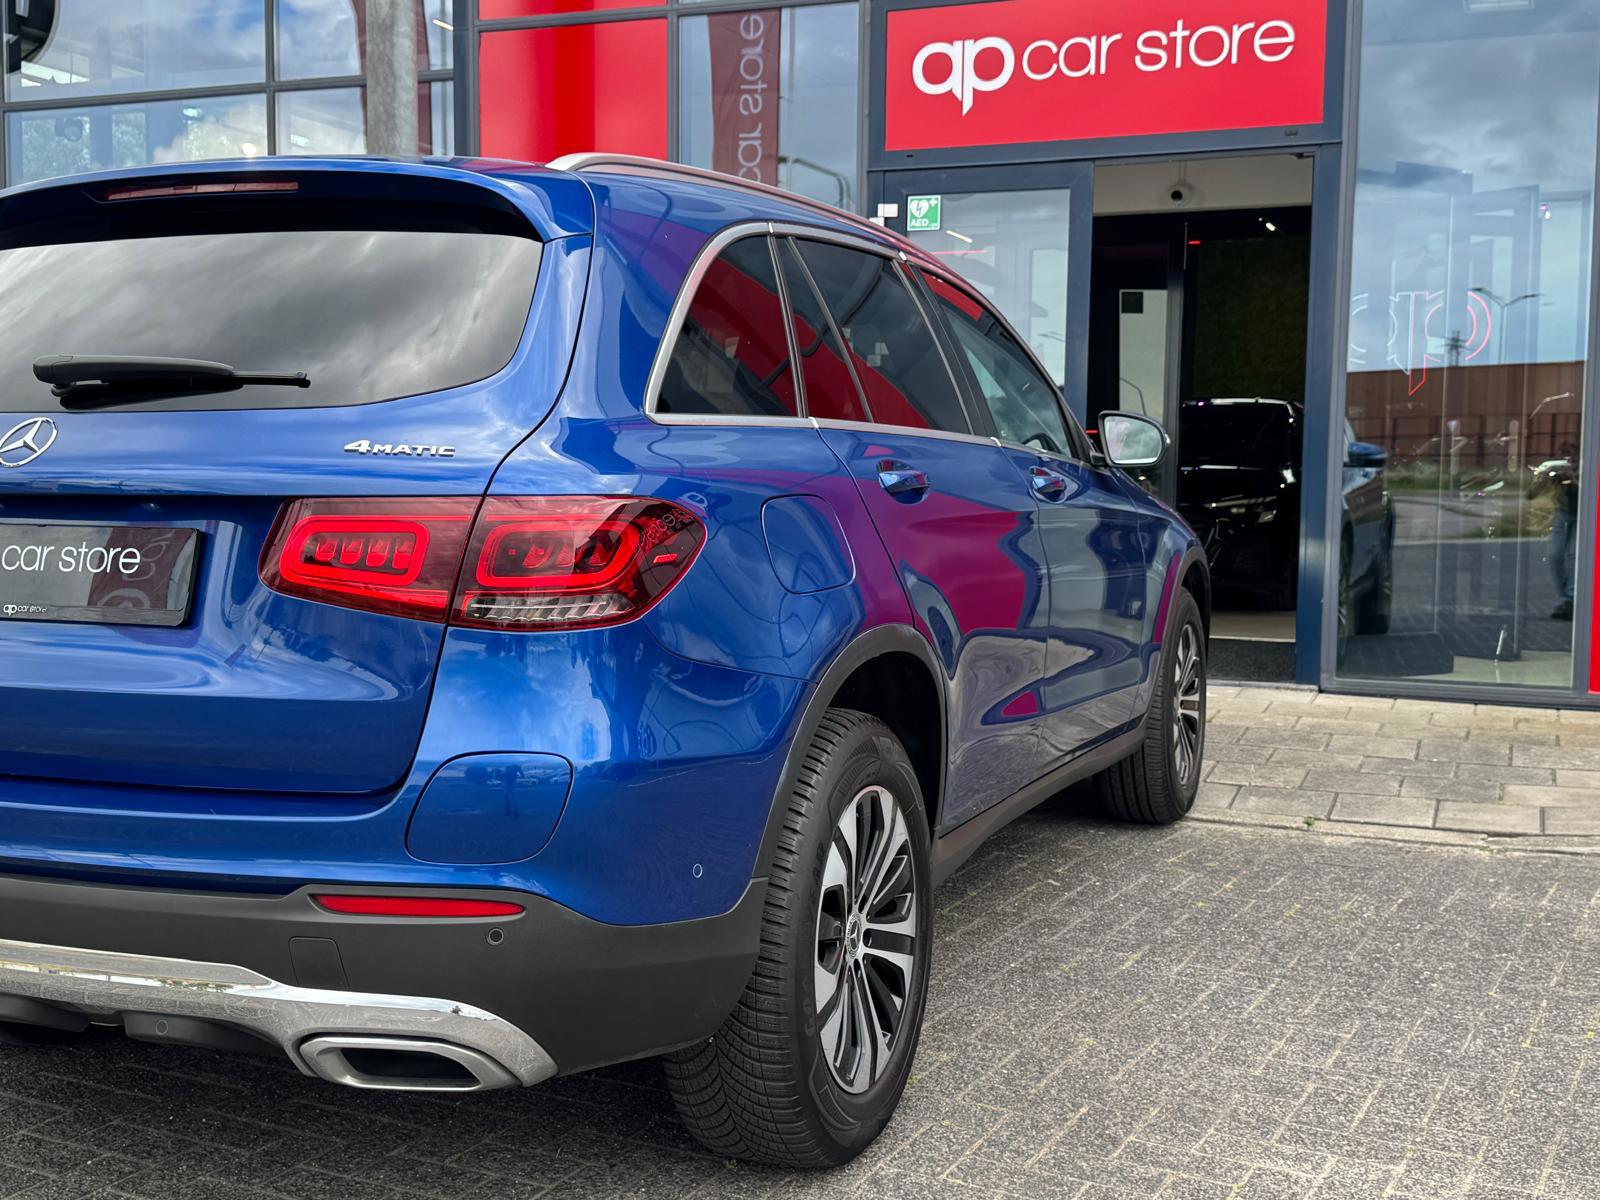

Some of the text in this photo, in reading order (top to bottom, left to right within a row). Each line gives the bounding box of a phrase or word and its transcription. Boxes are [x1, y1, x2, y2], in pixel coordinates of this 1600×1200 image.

[912, 19, 1296, 116] ap car store
[911, 218, 929, 227] AED
[343, 439, 456, 457] 4MATIC
[1, 541, 141, 574] car store
